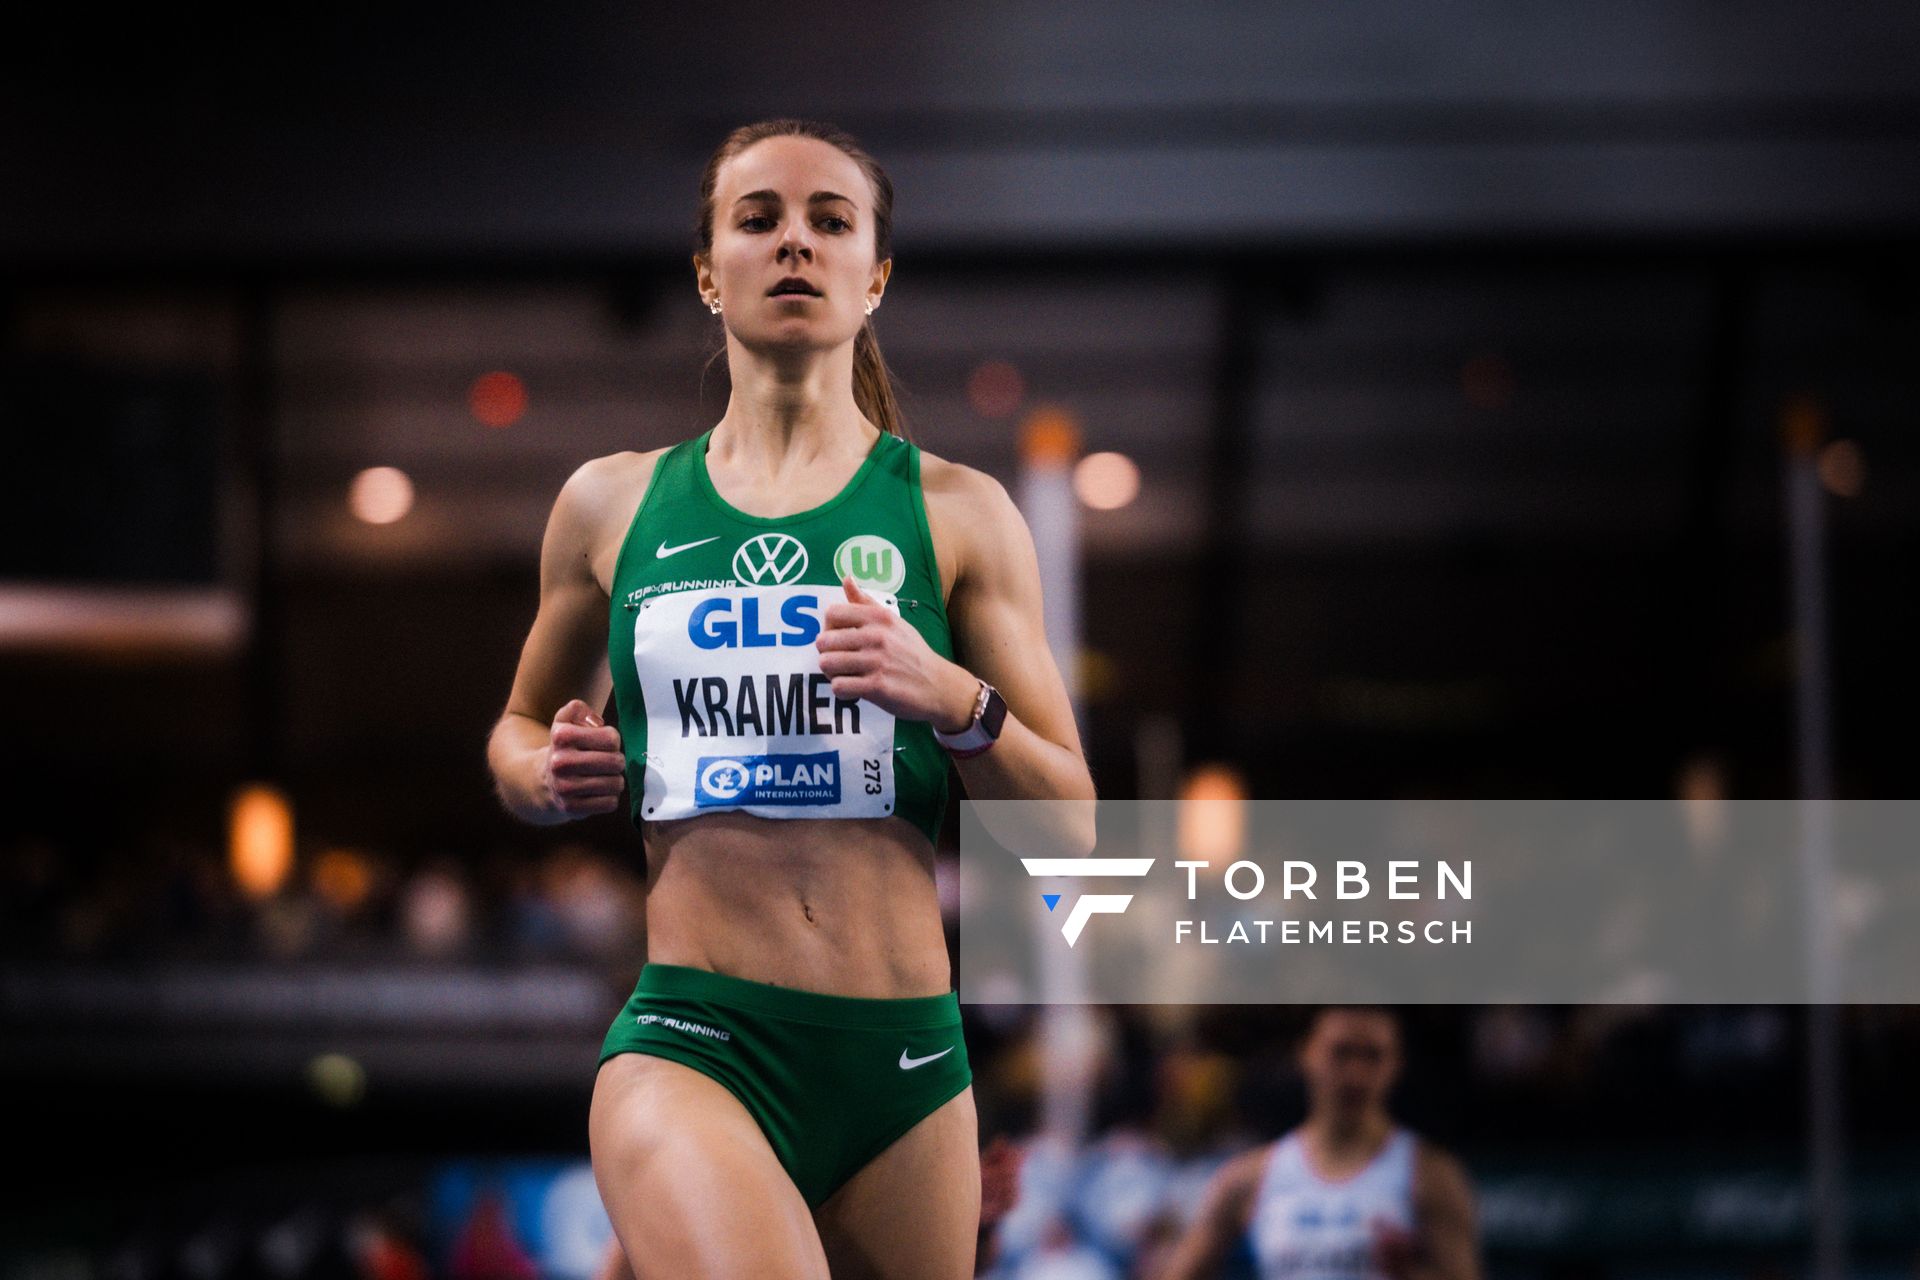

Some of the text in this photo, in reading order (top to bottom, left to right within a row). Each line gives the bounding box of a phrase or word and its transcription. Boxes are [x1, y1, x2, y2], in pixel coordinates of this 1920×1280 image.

[688, 595, 820, 650] GLS
[673, 673, 861, 738] KRAMER
[755, 763, 834, 787] PLAN
[863, 759, 882, 795] 273
[755, 789, 834, 798] INTERNATIONAL
